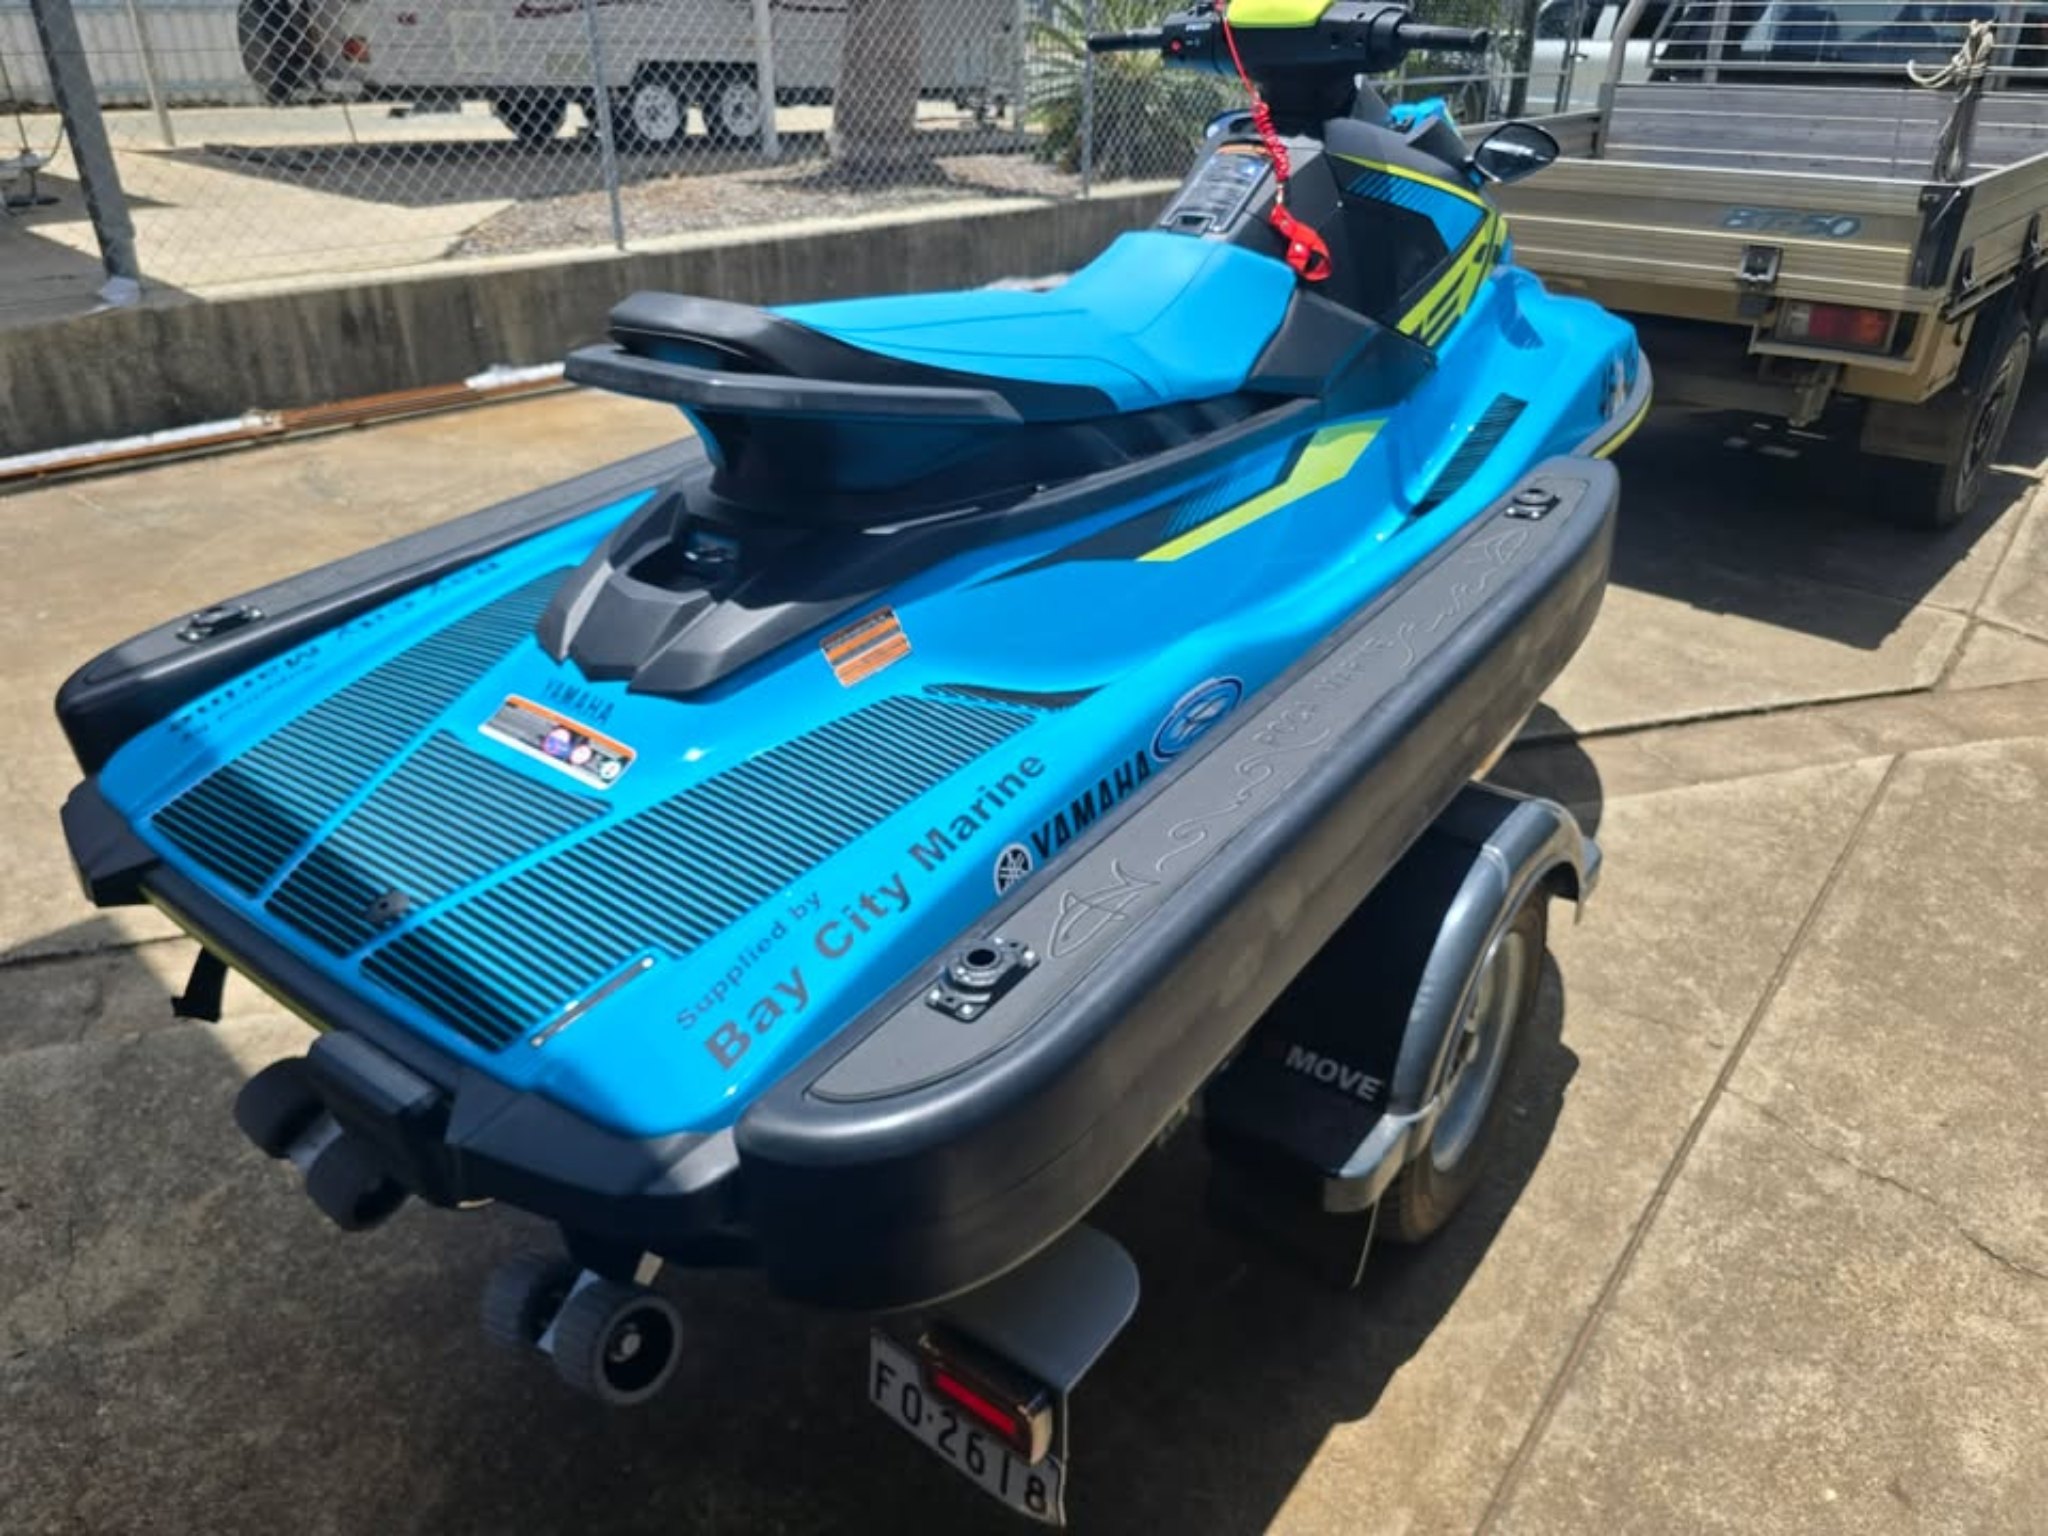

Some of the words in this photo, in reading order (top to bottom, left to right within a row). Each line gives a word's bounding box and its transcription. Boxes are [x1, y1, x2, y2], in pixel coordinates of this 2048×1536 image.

[1030, 750, 1150, 860] YAMAHA
[676, 921, 787, 1030] Supplied
[789, 891, 821, 920] by
[704, 966, 809, 1071] Bay
[814, 871, 911, 959] City
[907, 755, 1046, 872] Marine
[1285, 1044, 1383, 1102] MOVE
